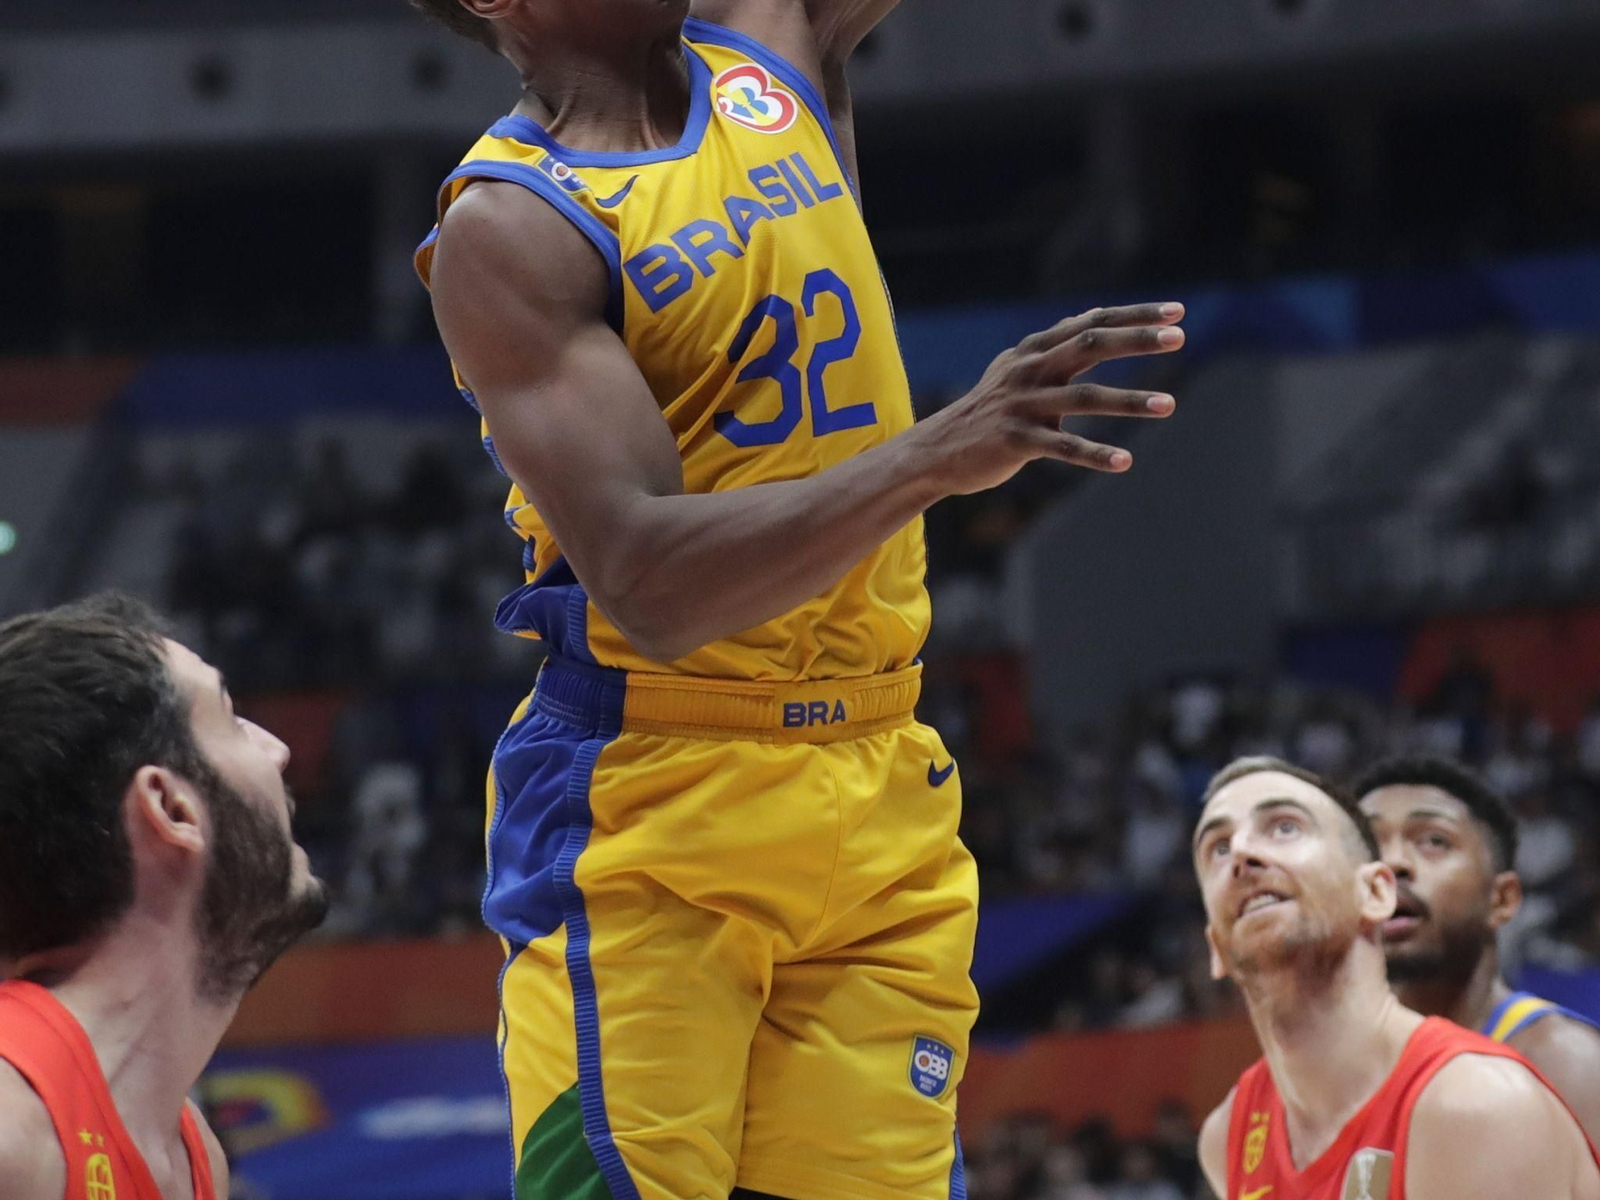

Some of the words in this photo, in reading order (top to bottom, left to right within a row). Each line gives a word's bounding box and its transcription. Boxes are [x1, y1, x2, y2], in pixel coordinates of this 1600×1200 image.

[623, 151, 844, 314] BRASIL
[713, 267, 878, 449] 32
[783, 699, 846, 728] BRA
